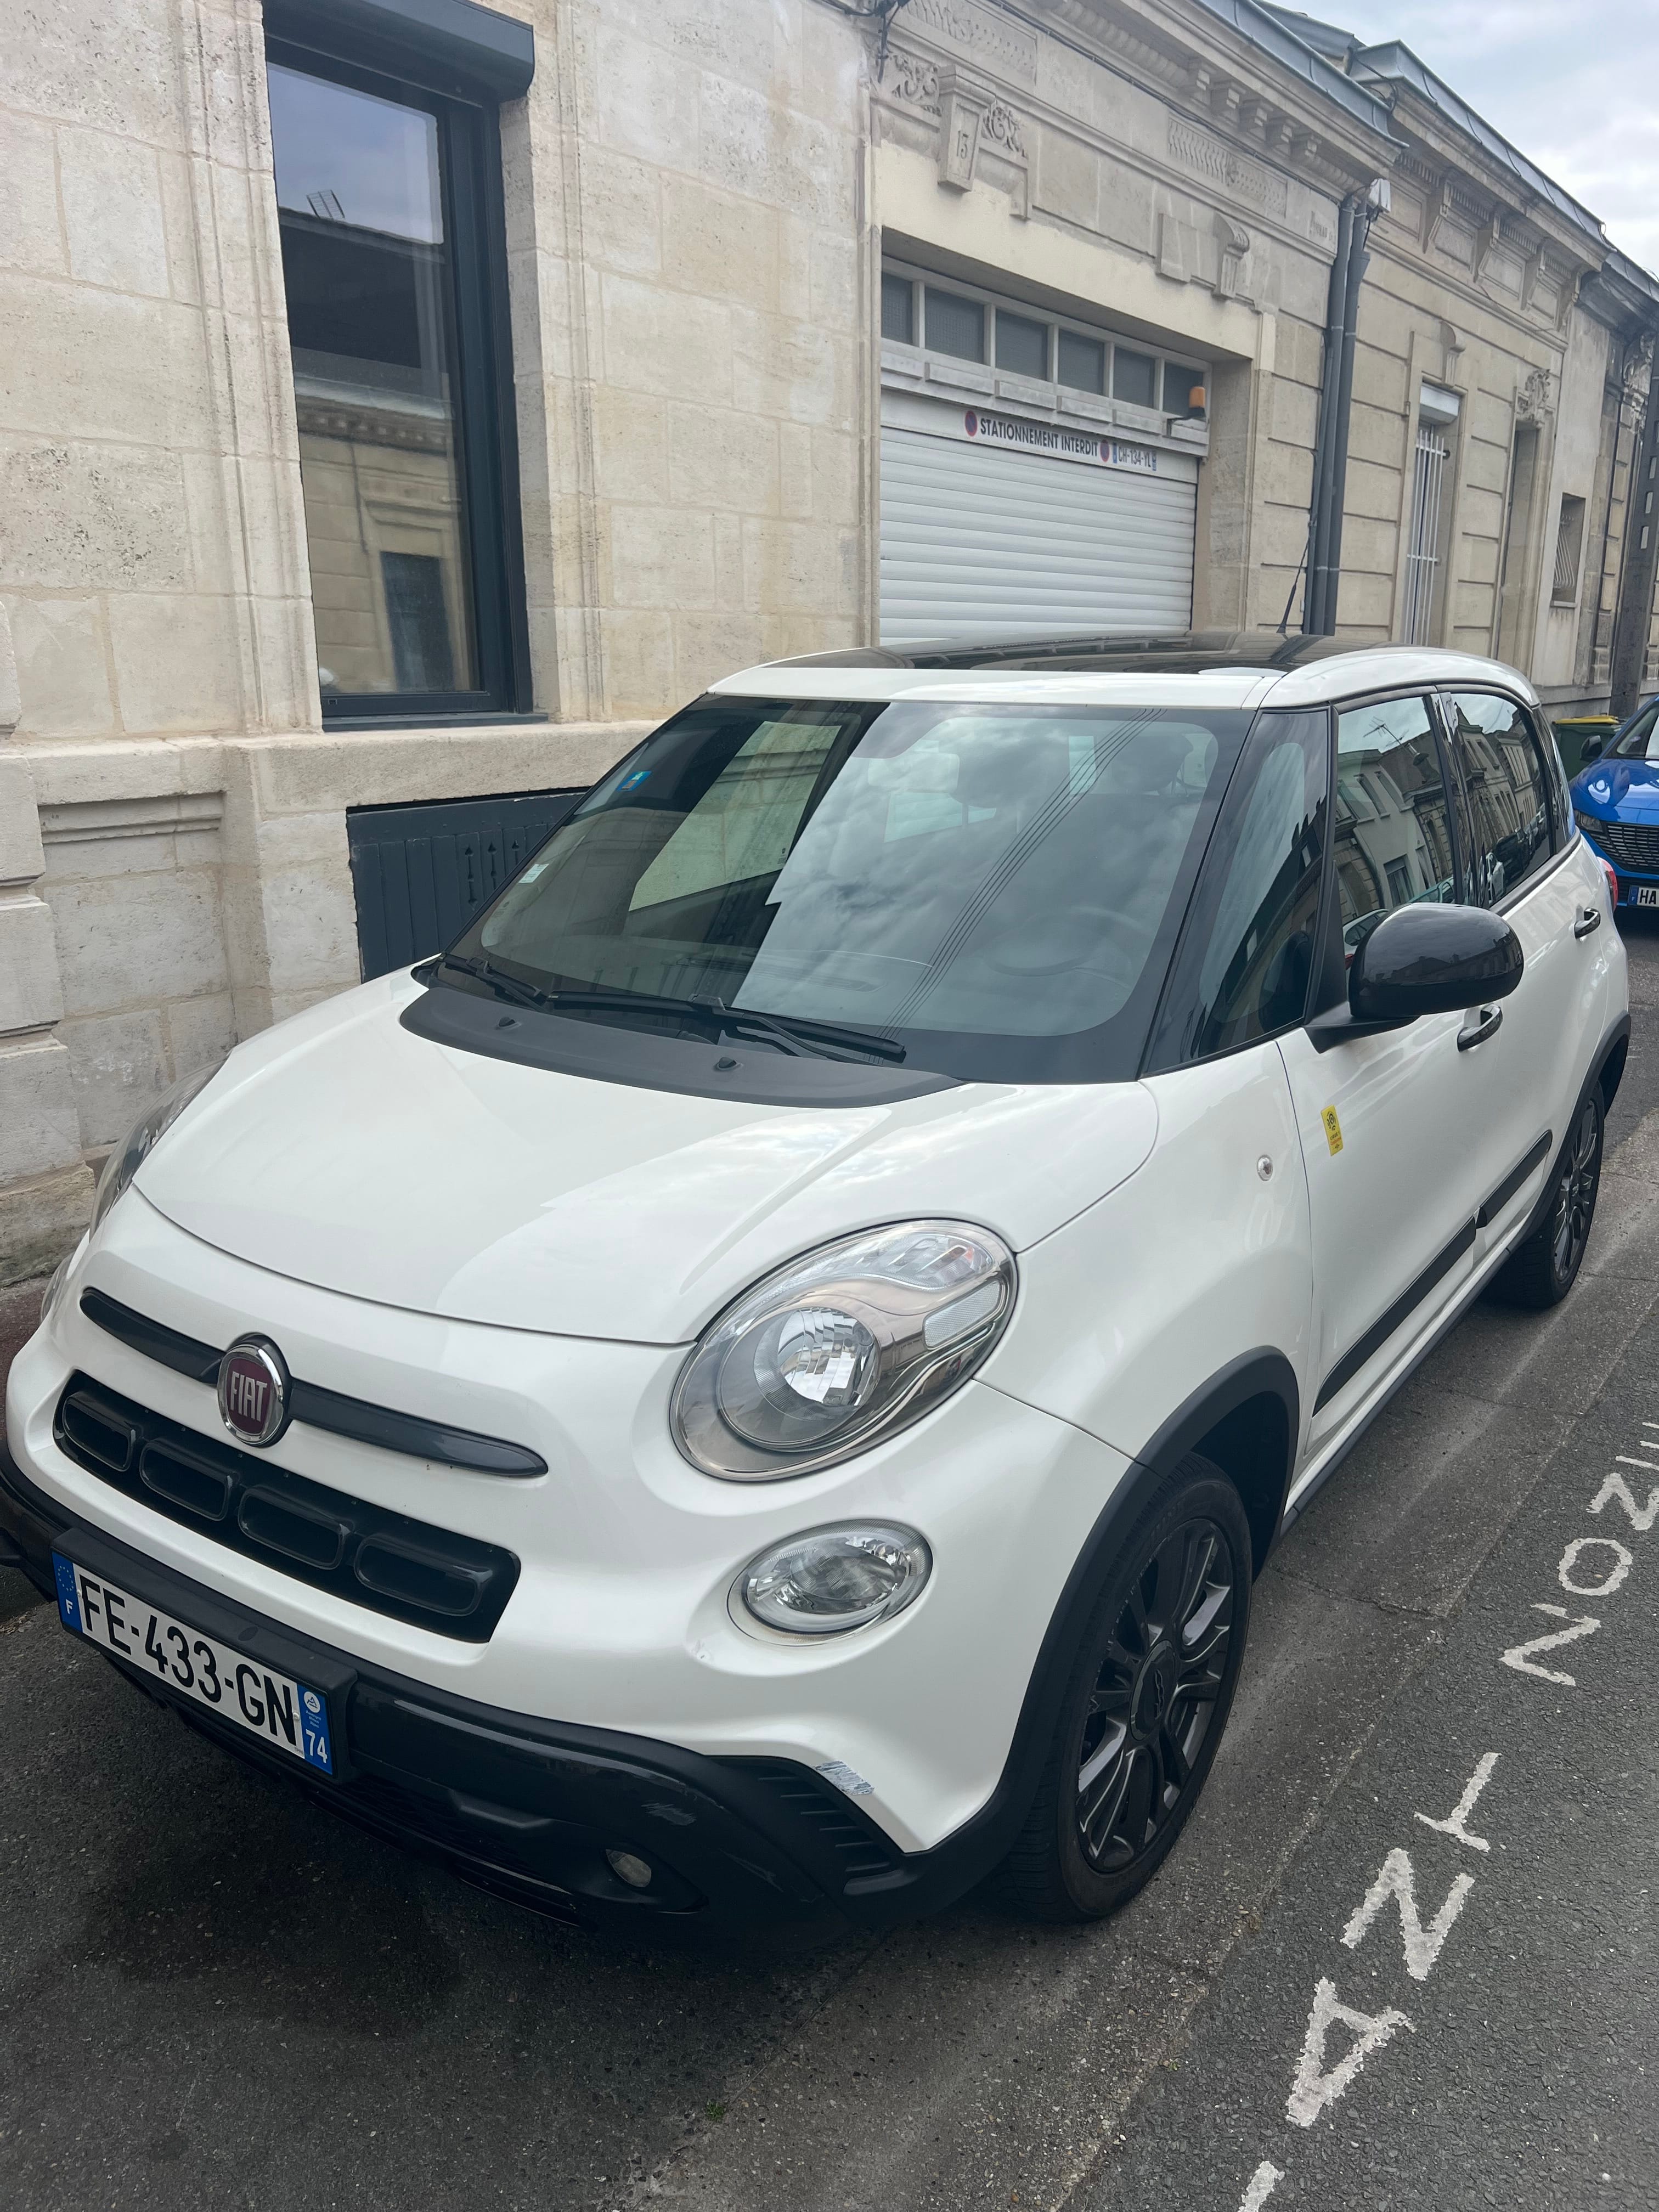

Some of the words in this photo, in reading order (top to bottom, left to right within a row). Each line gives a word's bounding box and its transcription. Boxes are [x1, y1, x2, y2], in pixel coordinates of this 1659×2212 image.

[980, 417, 1059, 449] STATIONNEMENT
[1061, 434, 1098, 457] INTERDIT
[230, 1370, 268, 1423] FIAT
[65, 1598, 74, 1615] F
[79, 1573, 297, 1747] FE-433-GN
[305, 1729, 328, 1764] 74
